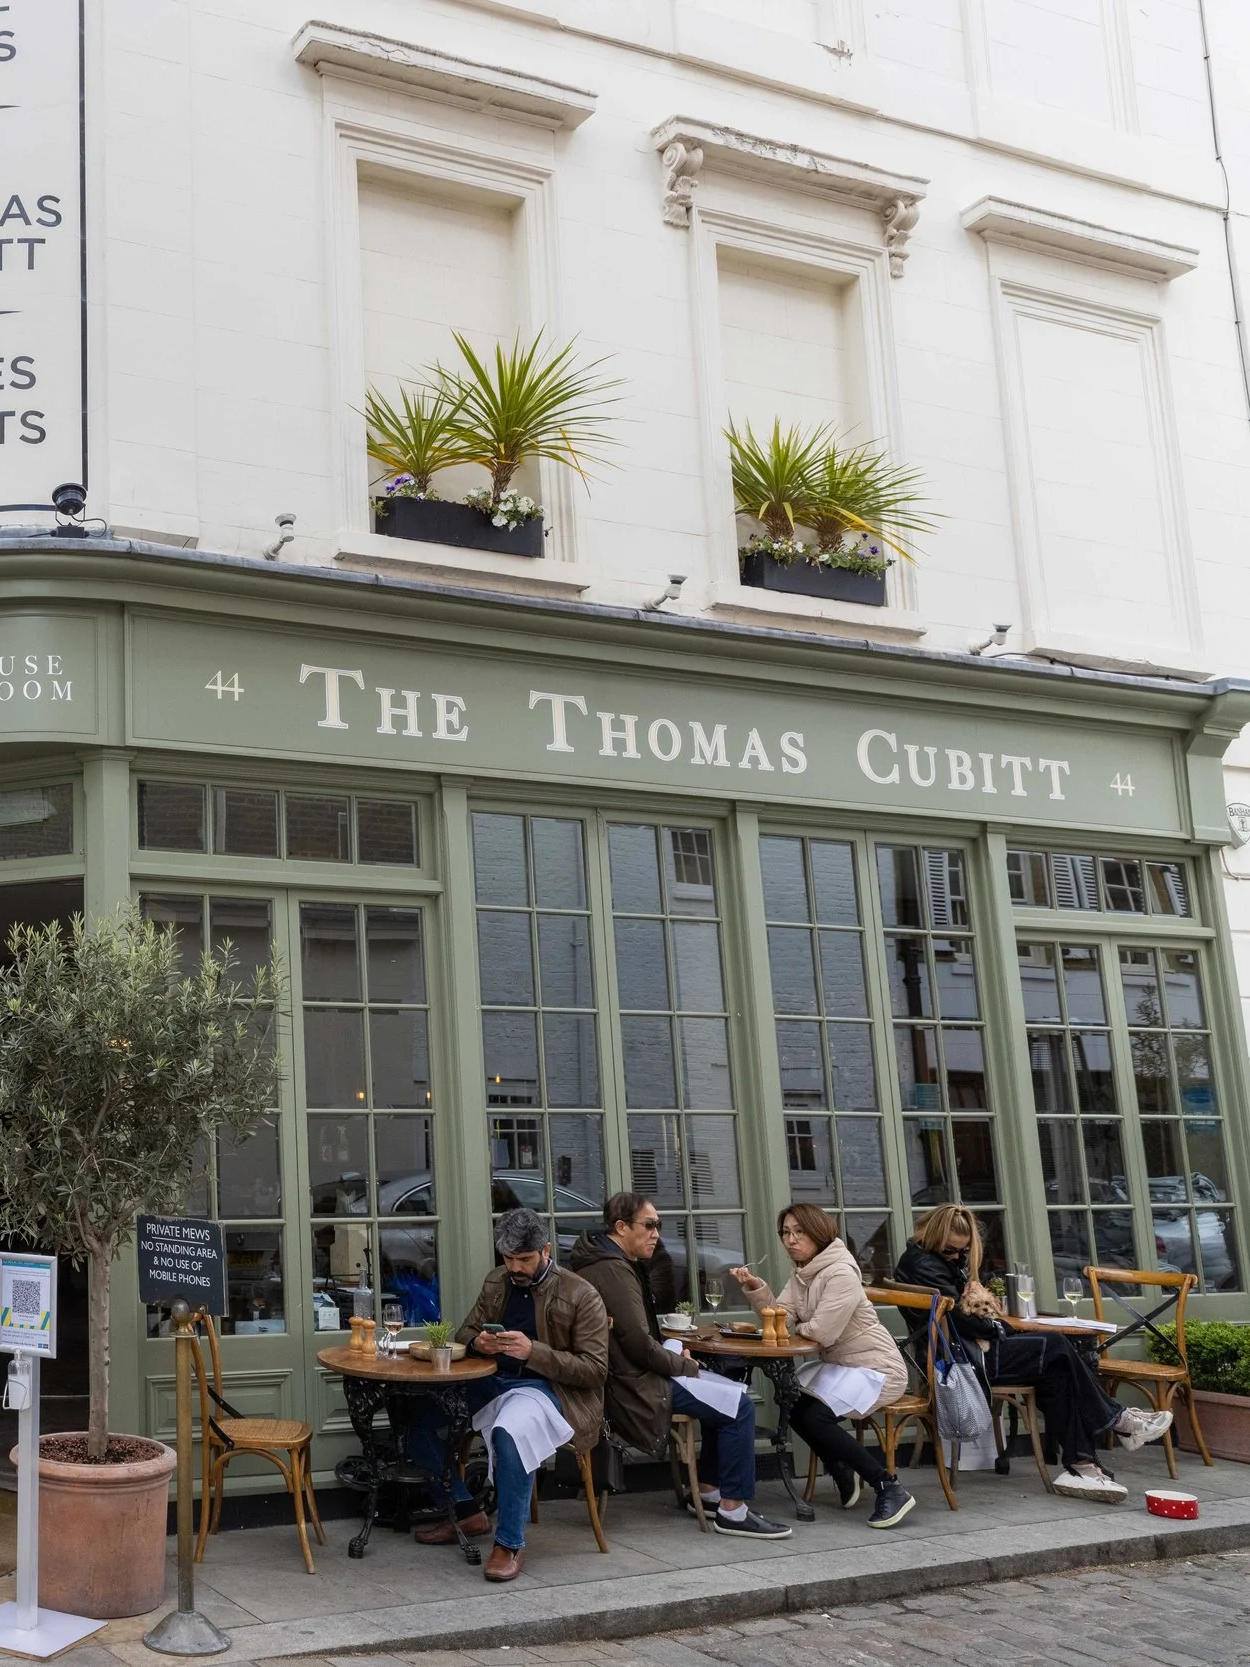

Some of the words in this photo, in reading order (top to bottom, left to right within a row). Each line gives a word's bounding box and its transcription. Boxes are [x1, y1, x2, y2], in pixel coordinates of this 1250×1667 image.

[204, 670, 244, 701] 44
[298, 663, 469, 742] THE
[528, 690, 808, 774] THOMAS
[856, 728, 1071, 800] CUBITT
[1109, 771, 1136, 797] 44
[146, 1223, 180, 1237] PRIVATE
[182, 1227, 210, 1241] MEWS
[141, 1240, 154, 1251] NO
[155, 1242, 196, 1257] STANDING
[196, 1247, 218, 1259] AREA
[153, 1256, 159, 1266] &
[160, 1257, 174, 1268] NO
[175, 1259, 190, 1270] USE
[191, 1261, 203, 1271] OF
[149, 1269, 177, 1282] MOBILE
[178, 1273, 211, 1287] PHONES
